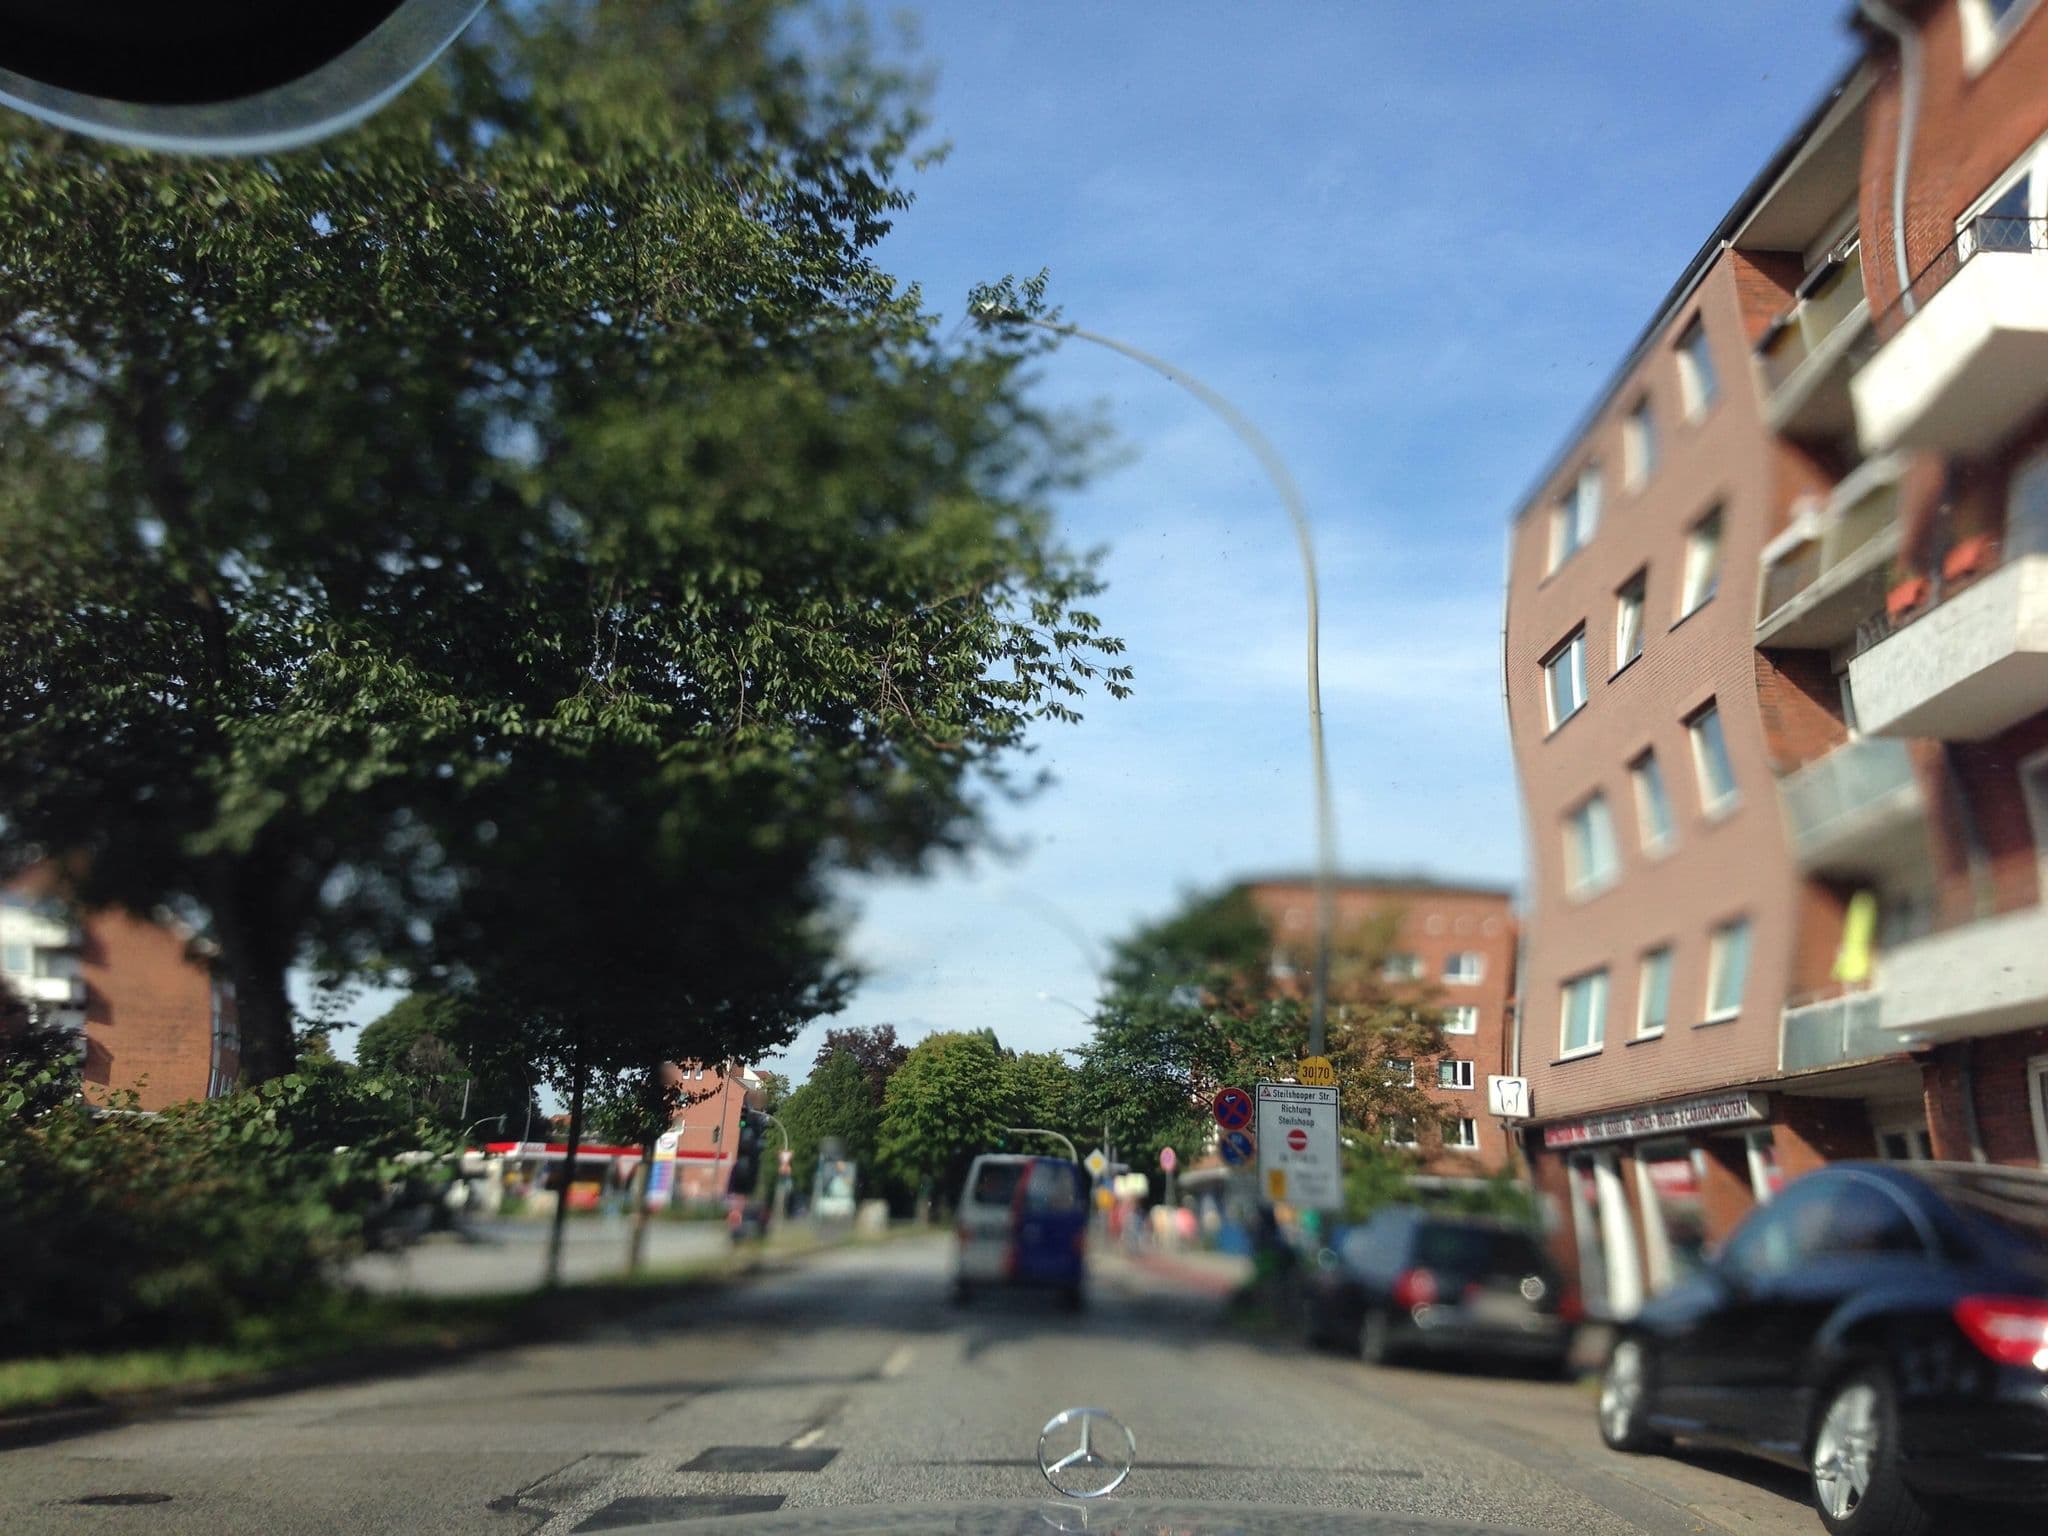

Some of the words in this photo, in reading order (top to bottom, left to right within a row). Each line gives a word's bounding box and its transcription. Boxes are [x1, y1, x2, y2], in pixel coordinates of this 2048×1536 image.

[1302, 1066, 1314, 1078] 30
[1318, 1067, 1330, 1079] 70
[1273, 1089, 1316, 1101] Steilshooper
[1281, 1104, 1311, 1117] Richtung
[1278, 1116, 1315, 1127] Steilshoop
